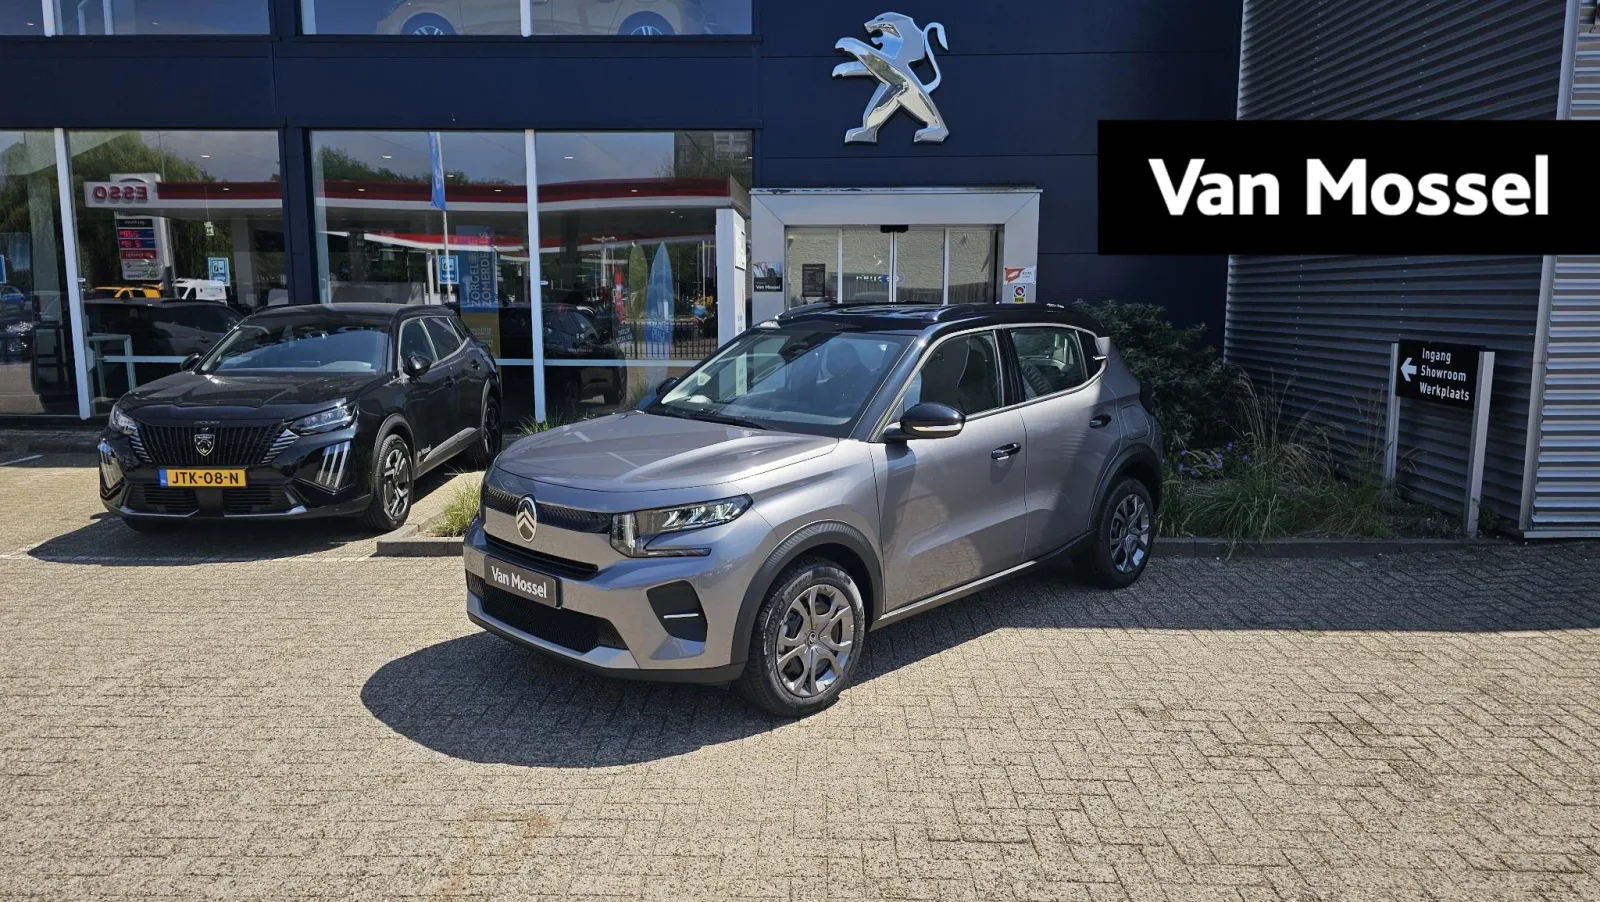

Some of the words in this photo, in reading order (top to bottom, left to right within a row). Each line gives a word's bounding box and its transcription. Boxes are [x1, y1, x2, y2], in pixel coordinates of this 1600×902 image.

[468, 239, 481, 306] ZORGELE
[479, 232, 492, 306] ZOMERDELS
[1422, 348, 1451, 364] Ingang
[1421, 365, 1466, 382] Showroom
[1420, 381, 1470, 401] Werkplaats
[172, 472, 239, 485] JTK-08-N
[491, 565, 510, 586] Van
[511, 572, 547, 599] Mossel
